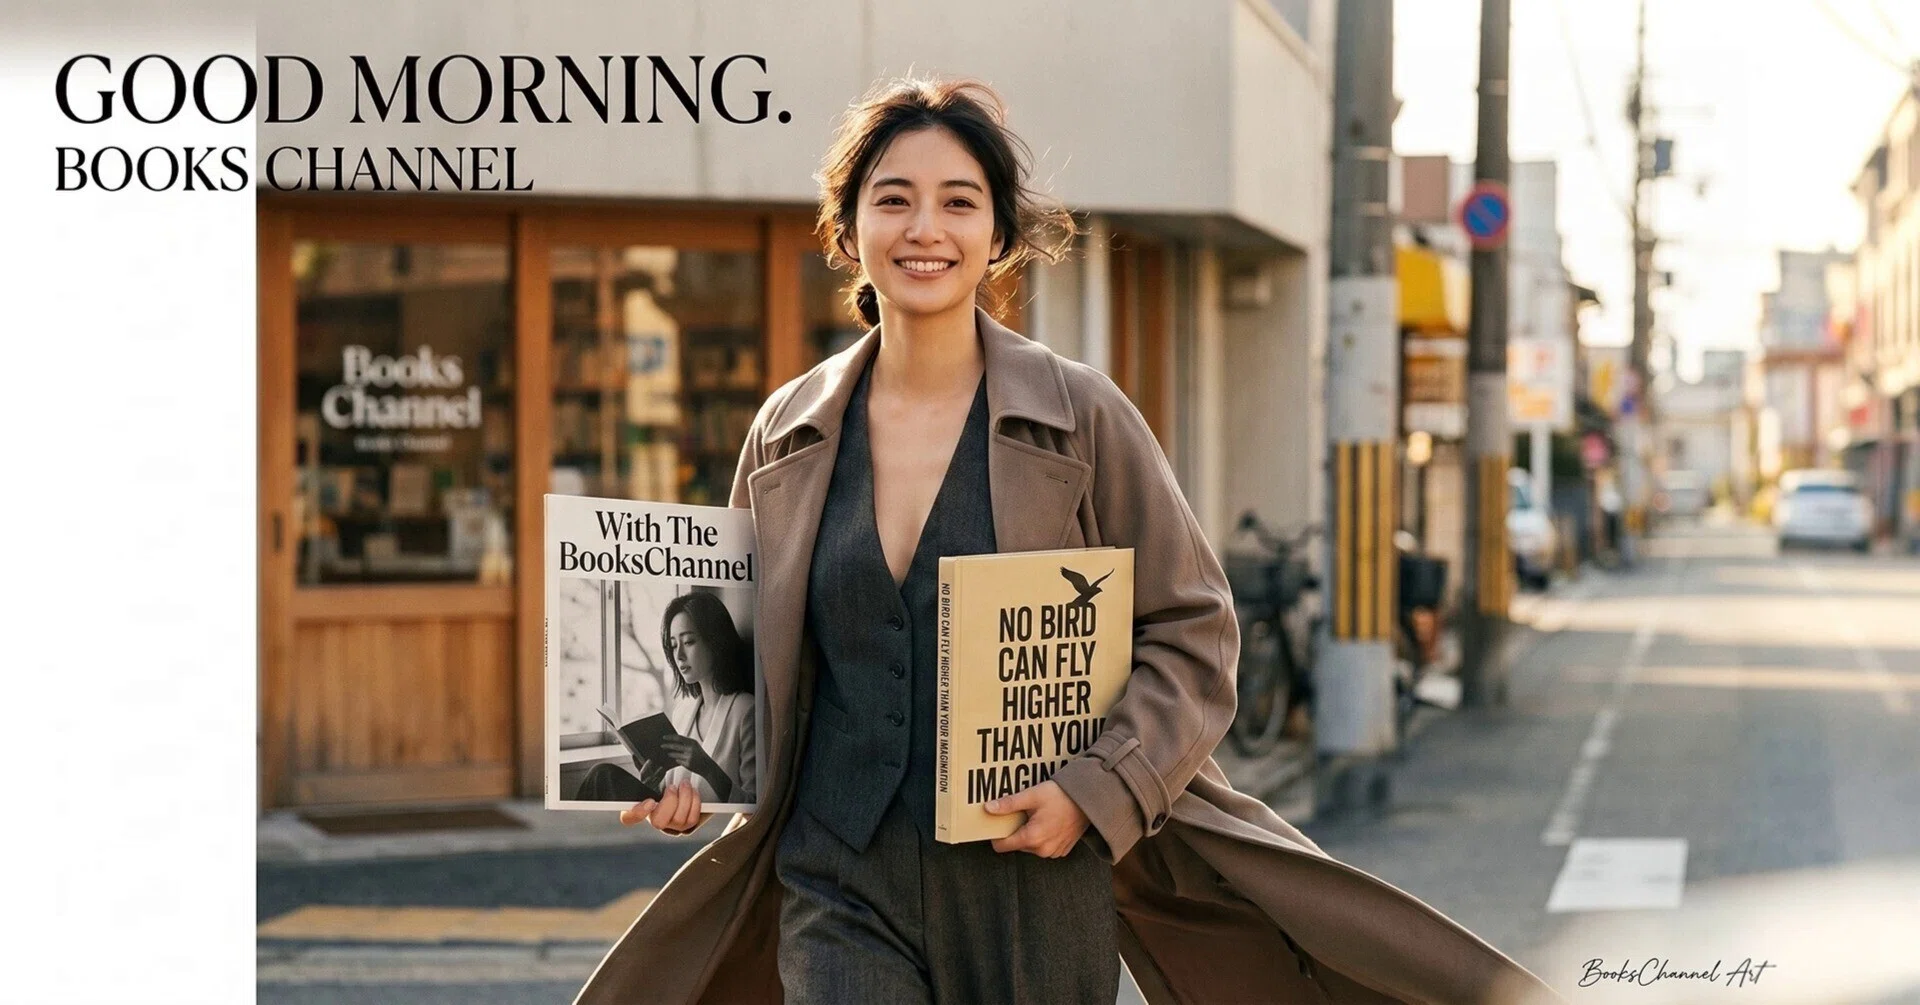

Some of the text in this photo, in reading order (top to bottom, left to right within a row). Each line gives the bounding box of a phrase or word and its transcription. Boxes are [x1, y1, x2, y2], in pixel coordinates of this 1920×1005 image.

[343, 345, 463, 388] Books
[322, 384, 482, 429] Channel
[595, 511, 718, 547] With The
[559, 541, 754, 582] BooksChannel
[999, 602, 1097, 643] NO BIRD
[998, 641, 1097, 682] CAN FLY
[939, 583, 951, 793] NO BIRD CAN FLY HIGHER THAN YOUR IMAGINATION
[1002, 680, 1091, 721] HIGHER
[976, 723, 1043, 763] THAN
[967, 759, 1068, 804] IMAGIN
